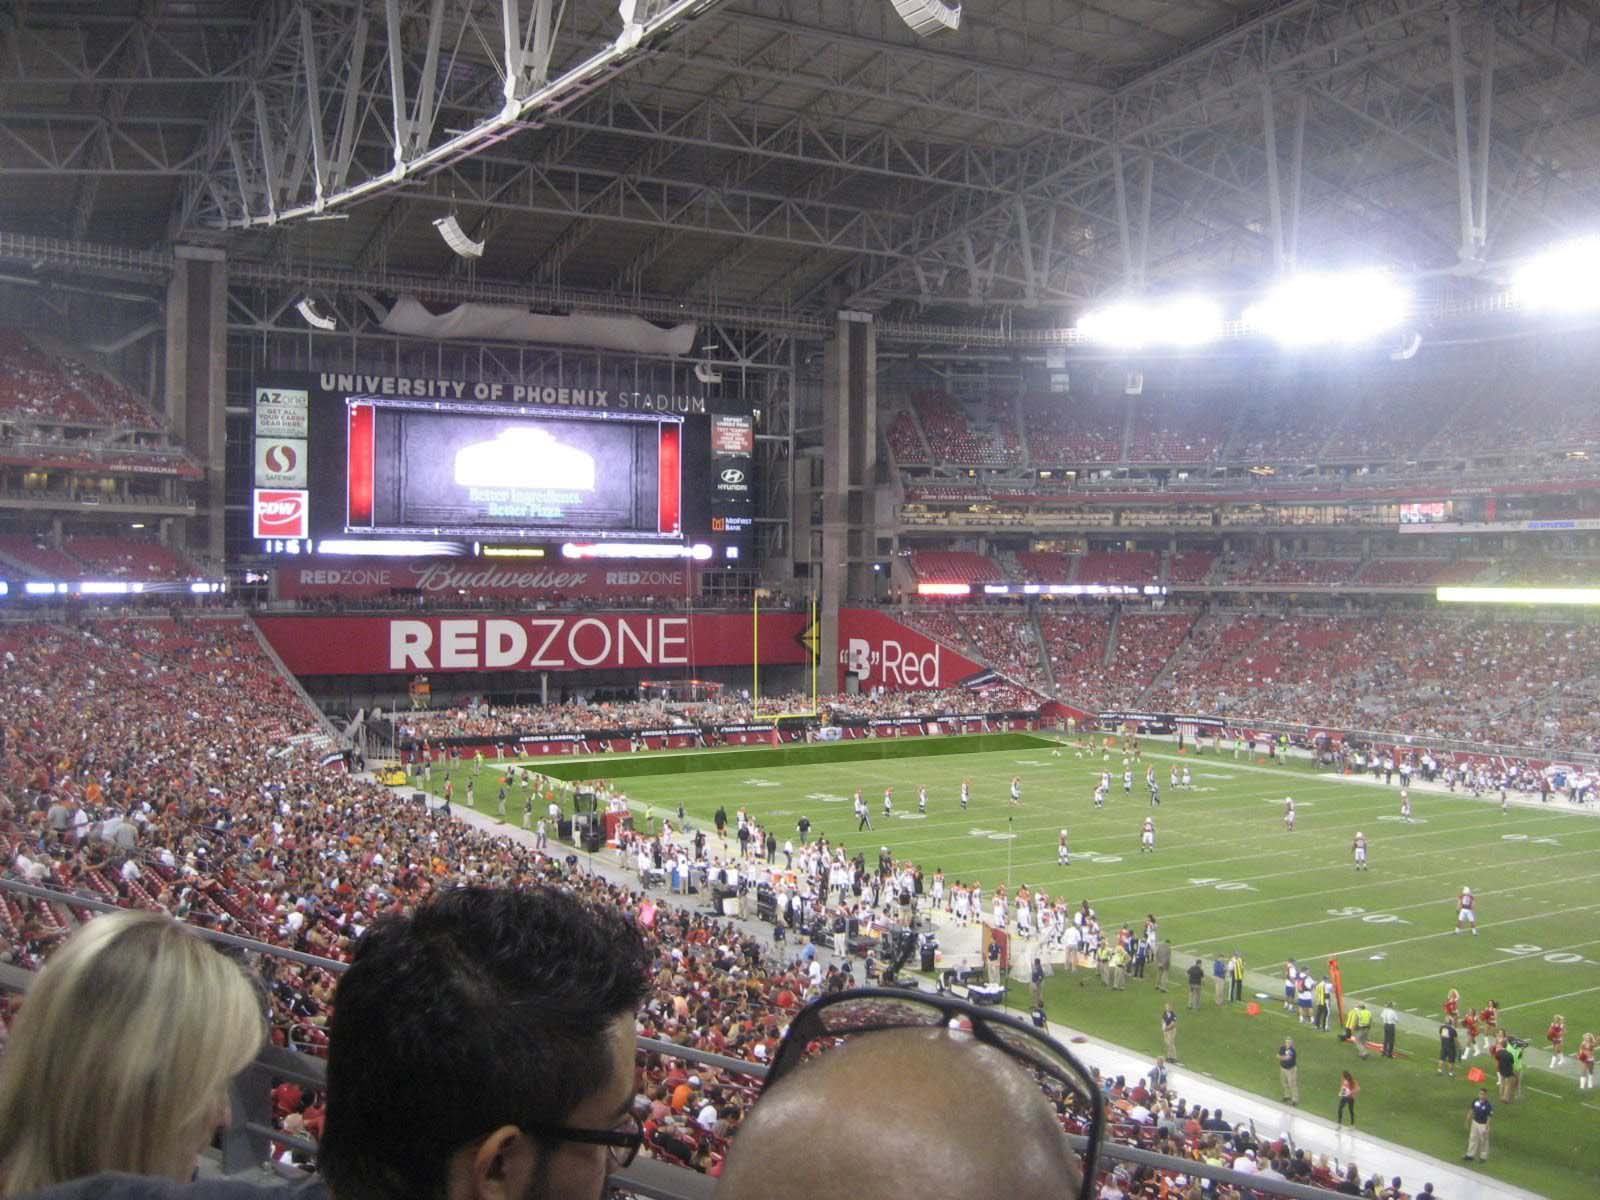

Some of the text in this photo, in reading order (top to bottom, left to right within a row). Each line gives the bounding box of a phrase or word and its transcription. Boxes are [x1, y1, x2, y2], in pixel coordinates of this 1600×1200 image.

[320, 373, 705, 413] UNIVERSITY OF PHOENIX STADIUM
[300, 569, 391, 585] REDZONE
[409, 561, 588, 591] Budweiser
[606, 571, 682, 585] REDZONE
[390, 618, 688, 669] REDZONE
